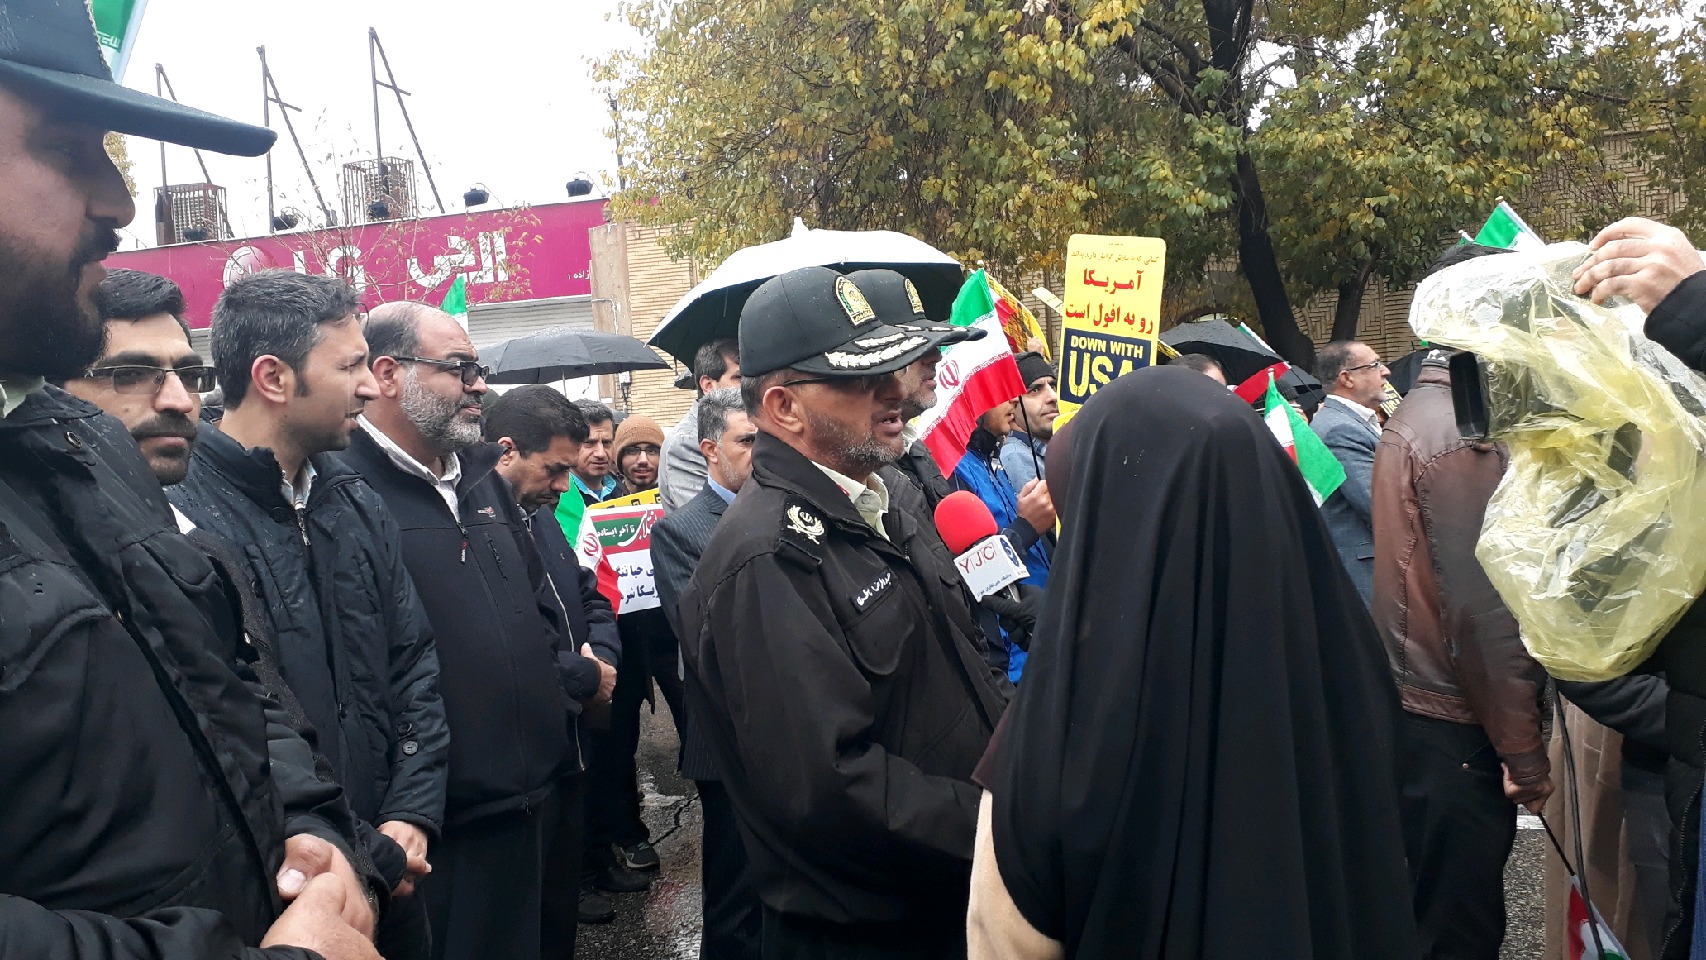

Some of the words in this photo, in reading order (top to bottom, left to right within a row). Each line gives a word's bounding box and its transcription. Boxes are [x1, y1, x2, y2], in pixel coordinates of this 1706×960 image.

[1084, 268, 1144, 294] آمریکا
[1065, 301, 1090, 319] است
[1093, 302, 1120, 327] افول
[1123, 309, 1135, 330] به
[1137, 315, 1153, 334] رو
[1070, 335, 1107, 352] DOWN
[1110, 340, 1143, 358] WITH
[959, 545, 995, 574] YJC
